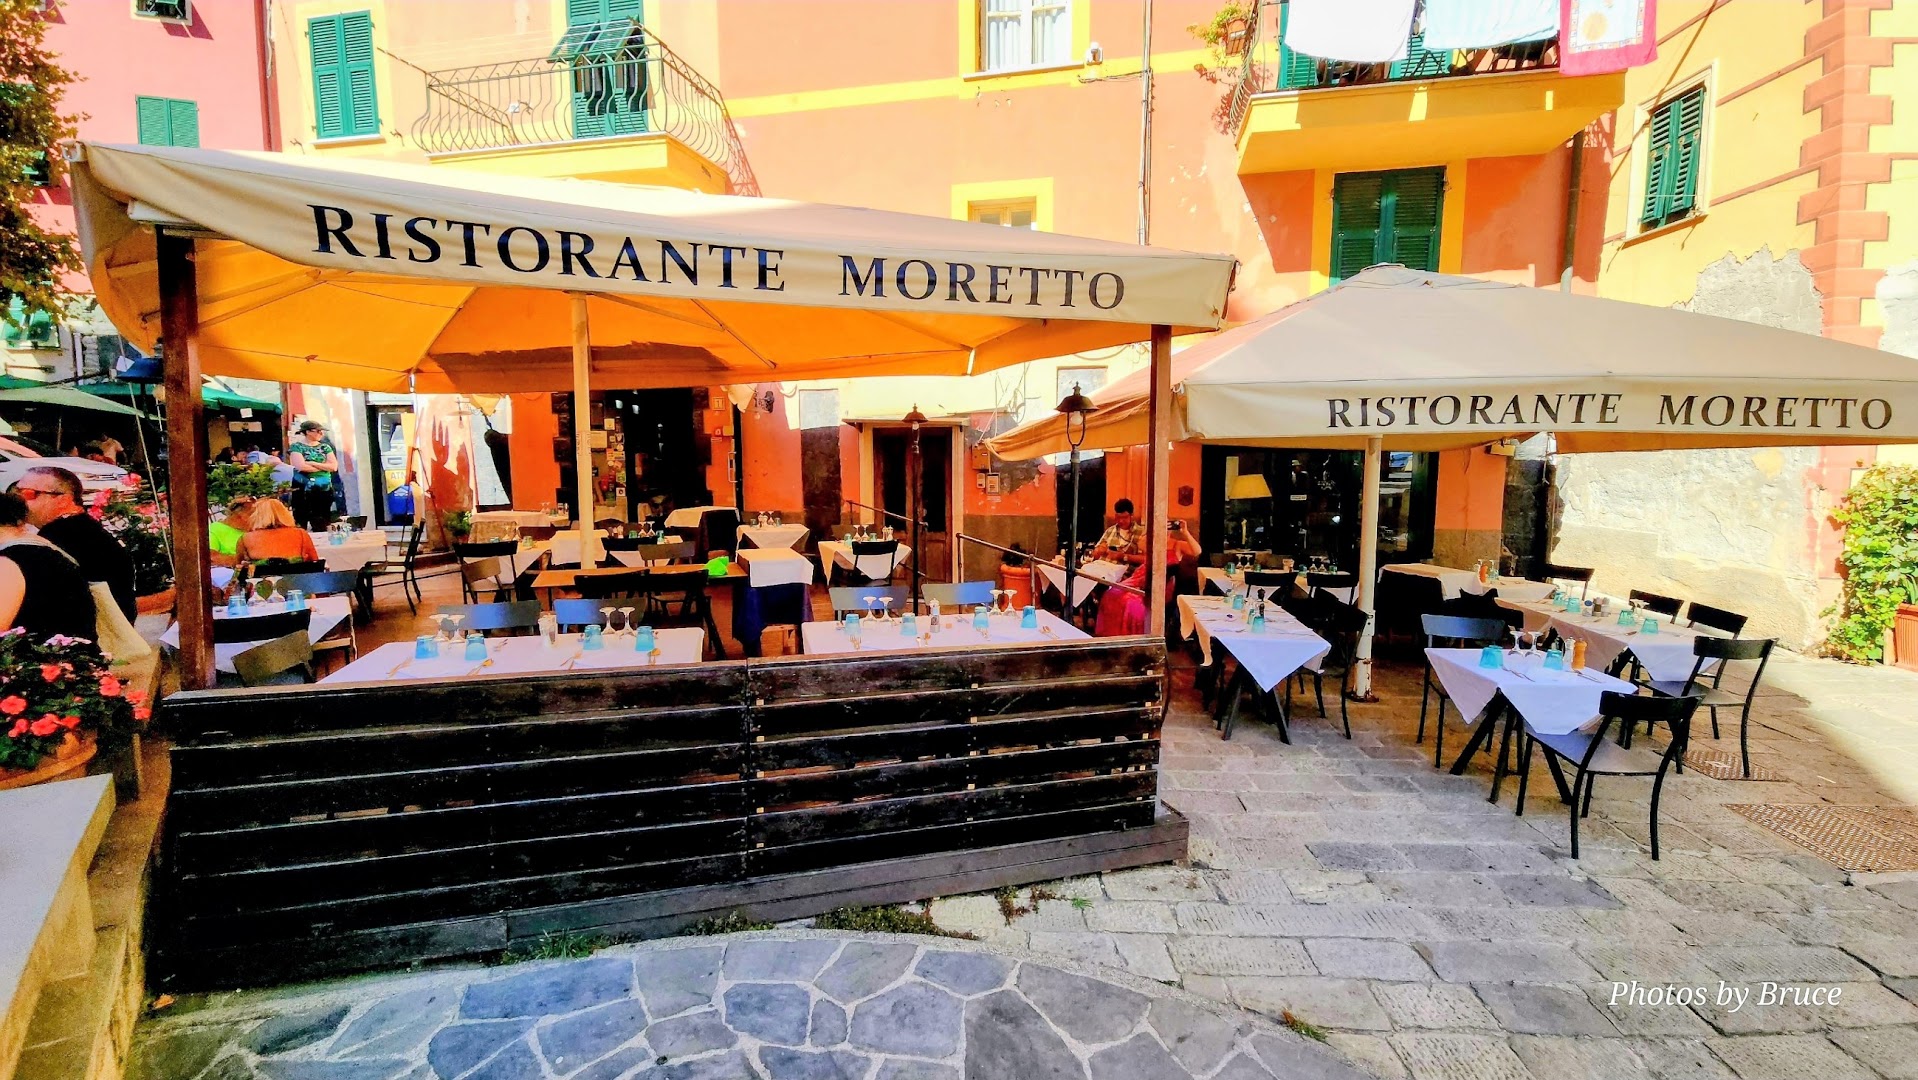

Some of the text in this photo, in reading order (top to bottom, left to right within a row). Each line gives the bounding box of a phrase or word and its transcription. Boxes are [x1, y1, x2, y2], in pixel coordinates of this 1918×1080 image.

[306, 204, 1125, 310] RISTORANTE MORETTO
[1326, 393, 1893, 430] RISTORANTE MORETTO
